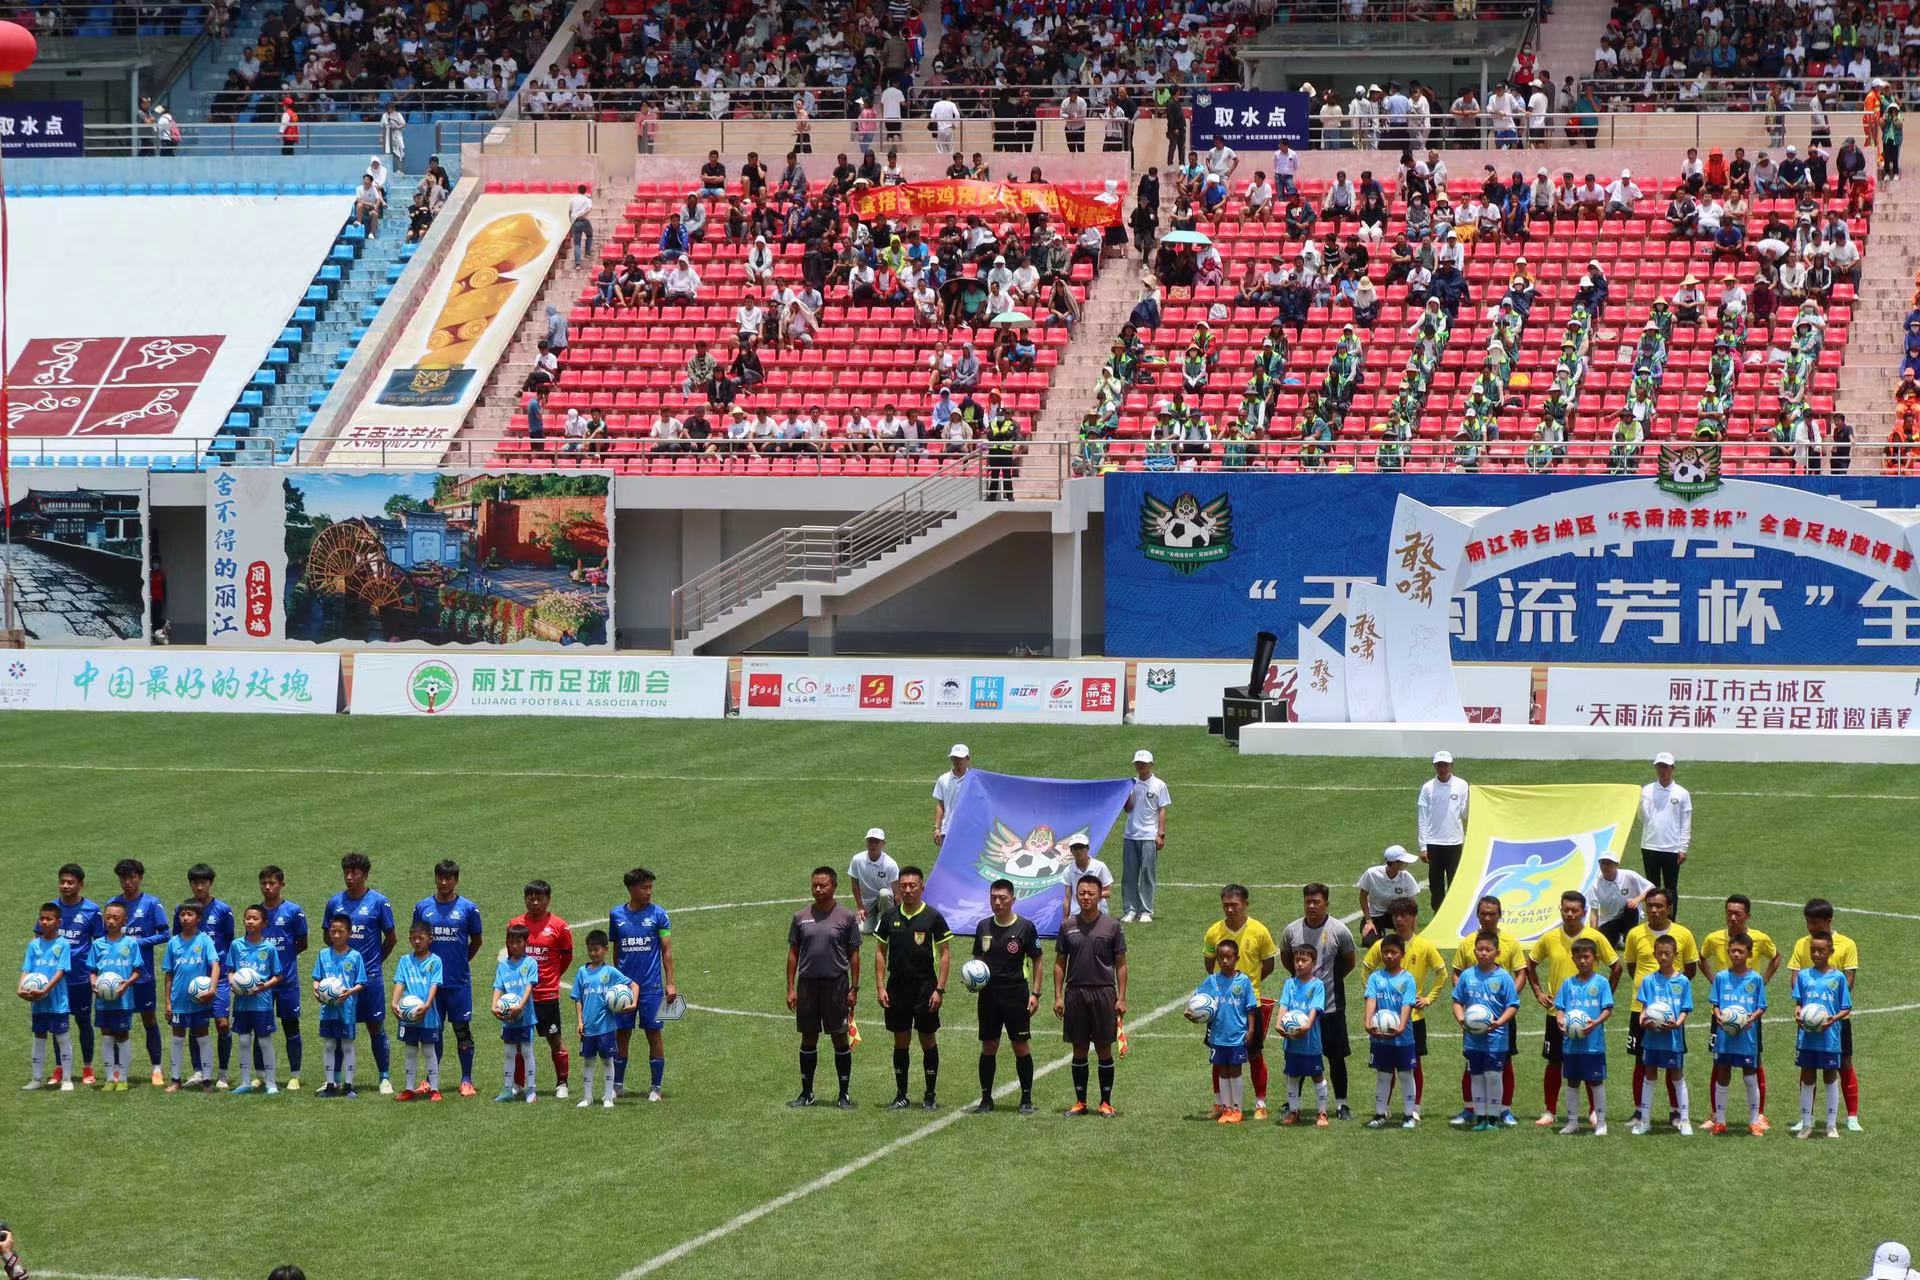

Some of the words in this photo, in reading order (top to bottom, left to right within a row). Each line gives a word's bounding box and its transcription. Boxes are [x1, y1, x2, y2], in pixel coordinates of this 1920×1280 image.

[0, 115, 63, 135] 取水点
[1214, 106, 1286, 127] 取水点
[343, 426, 448, 448] 天雨流芳杯
[1465, 515, 1597, 562] 丽江市古城区
[1608, 508, 1747, 529] “天雨流芳杯”
[1760, 514, 1914, 572] 全省足球邀请赛
[213, 472, 238, 636] 舍不得的丽江
[250, 566, 267, 633] 丽江古城
[73, 660, 312, 702] 中国最好的玫瑰
[471, 668, 670, 694] 丽江市足球协会
[1669, 678, 1826, 703] 丽江市古城区
[471, 697, 517, 707] LIJIANG
[522, 698, 581, 708] FOOTBALL
[586, 699, 667, 708] ASSOCIATION
[1519, 906, 1553, 916] GAME
[1522, 914, 1551, 923] PLAY
